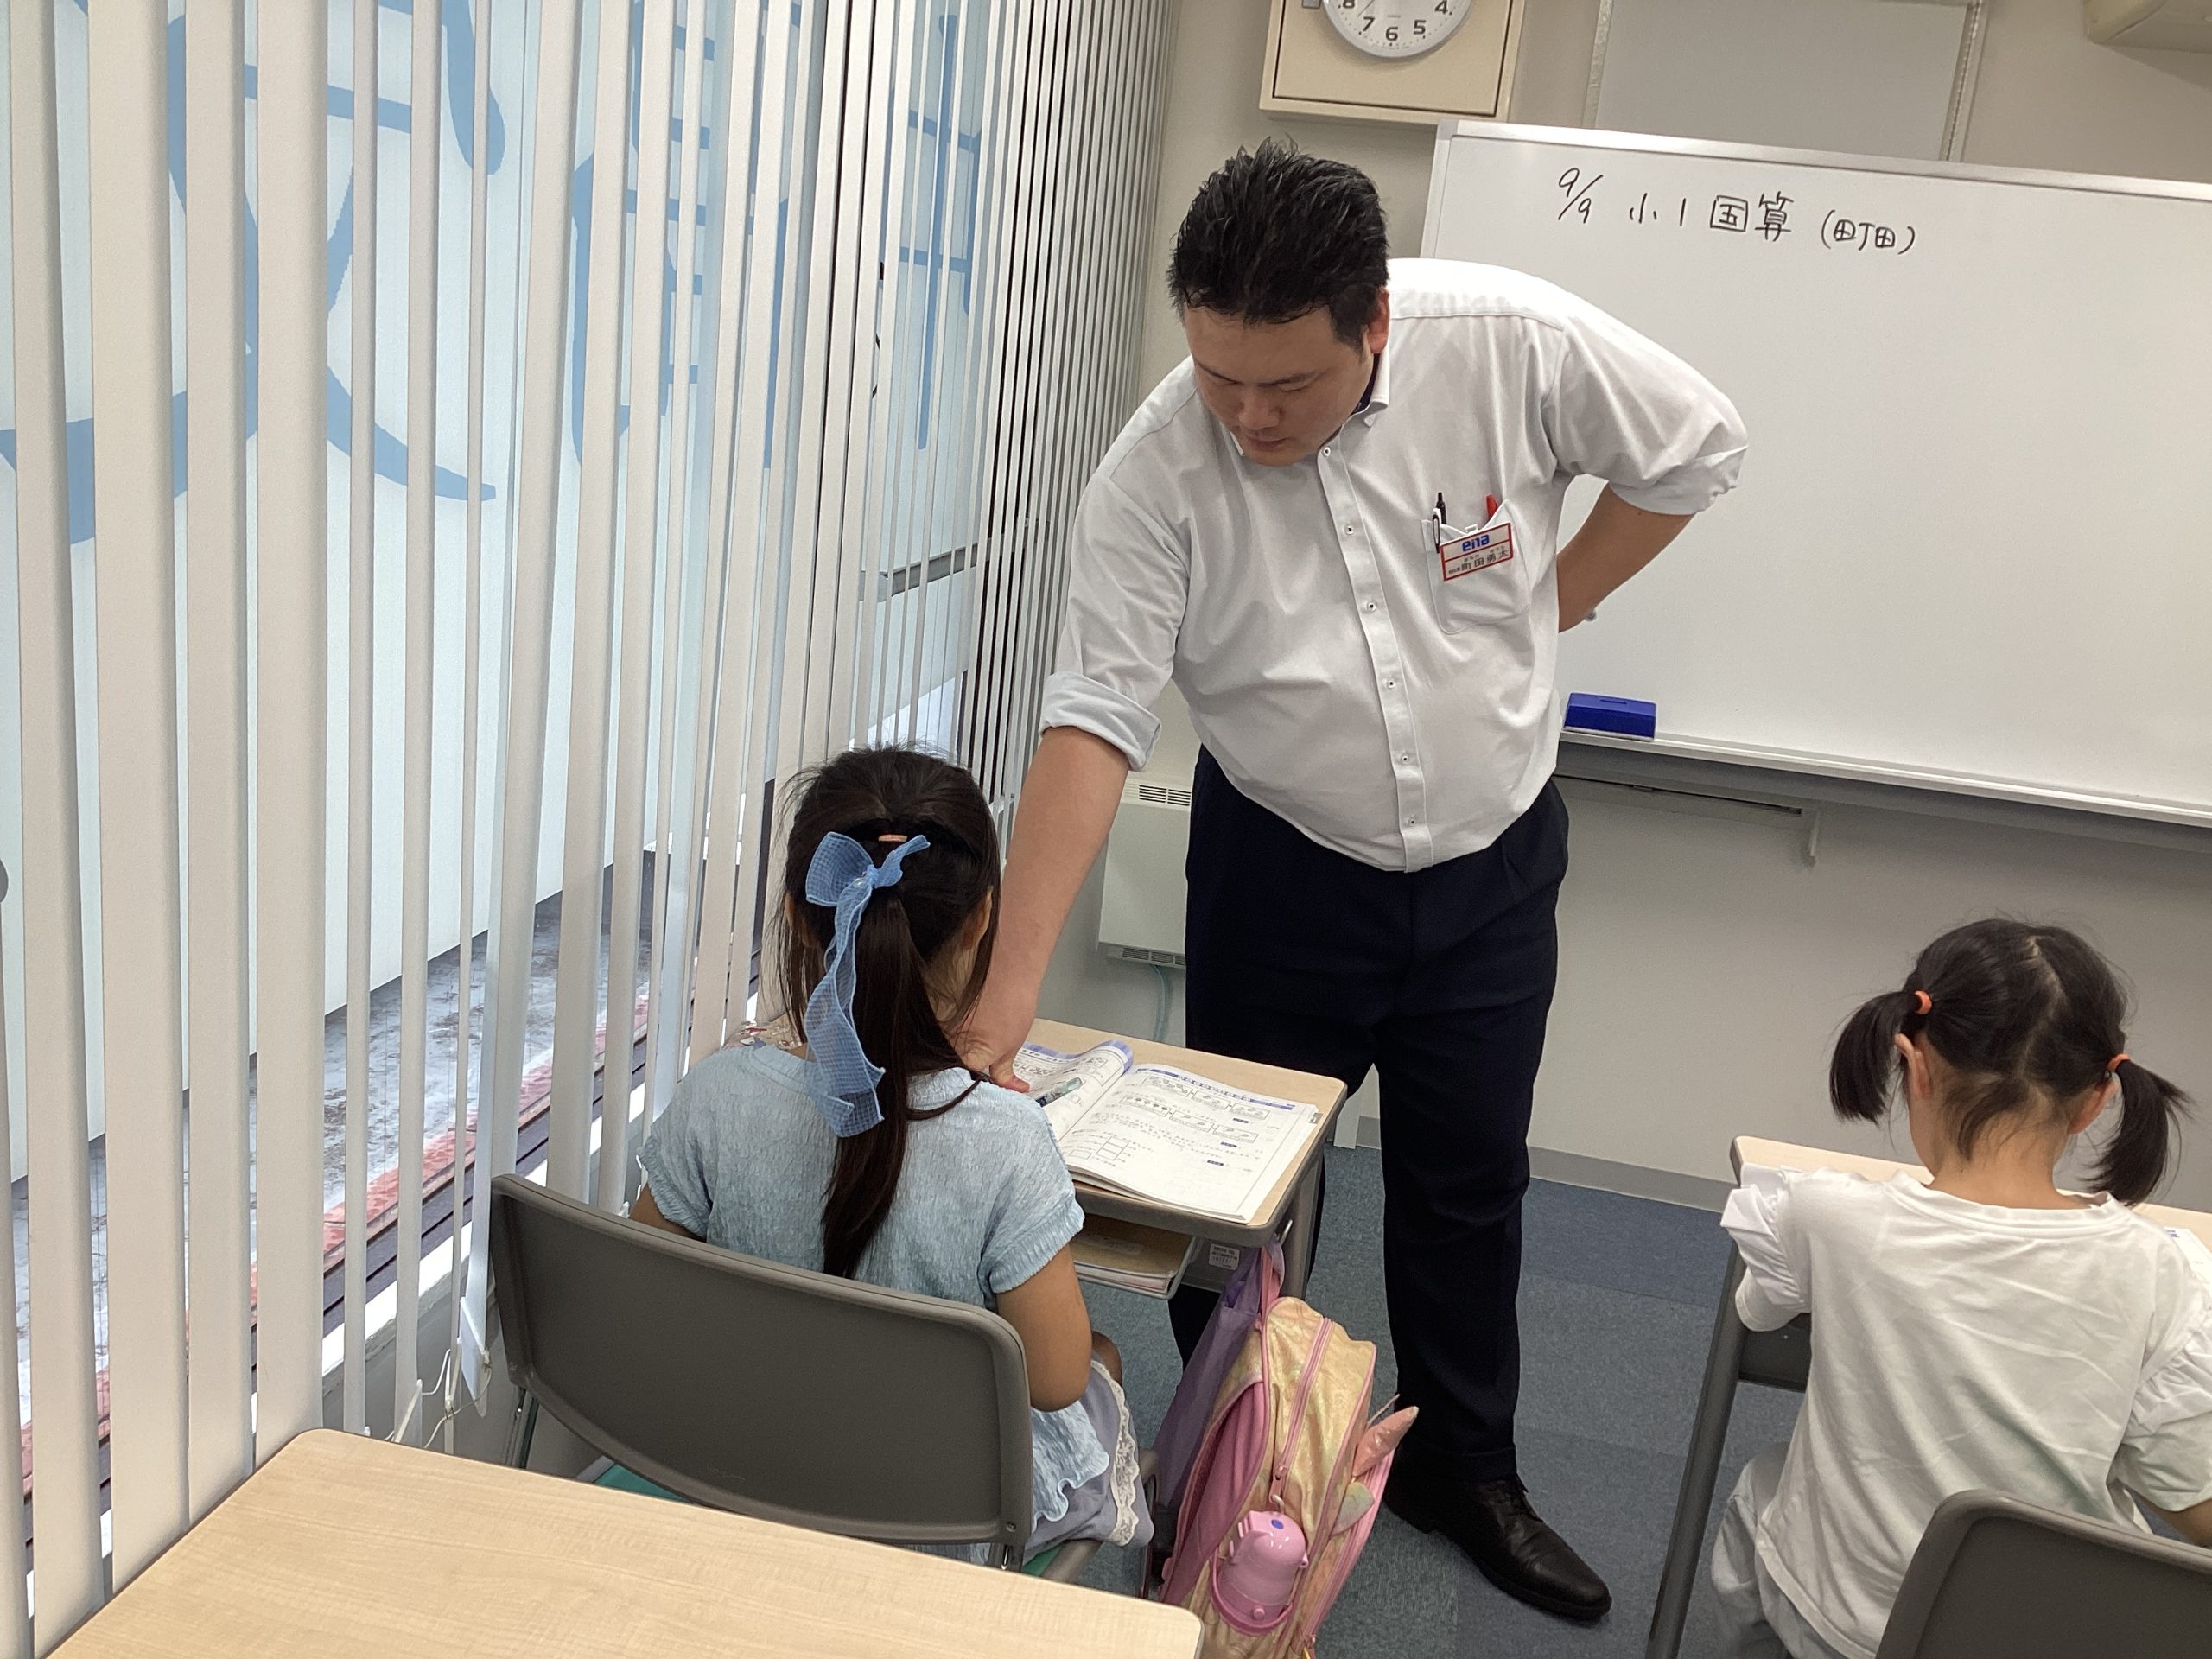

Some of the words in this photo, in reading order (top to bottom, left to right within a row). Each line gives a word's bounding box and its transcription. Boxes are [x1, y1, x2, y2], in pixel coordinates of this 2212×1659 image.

[1434, 0, 1448, 14] 4
[1363, 16, 1376, 32] 7
[1413, 20, 1427, 35] 5
[1385, 26, 1399, 41] 6
[1558, 167, 1604, 225] 9/9
[1462, 534, 1490, 552] ena
